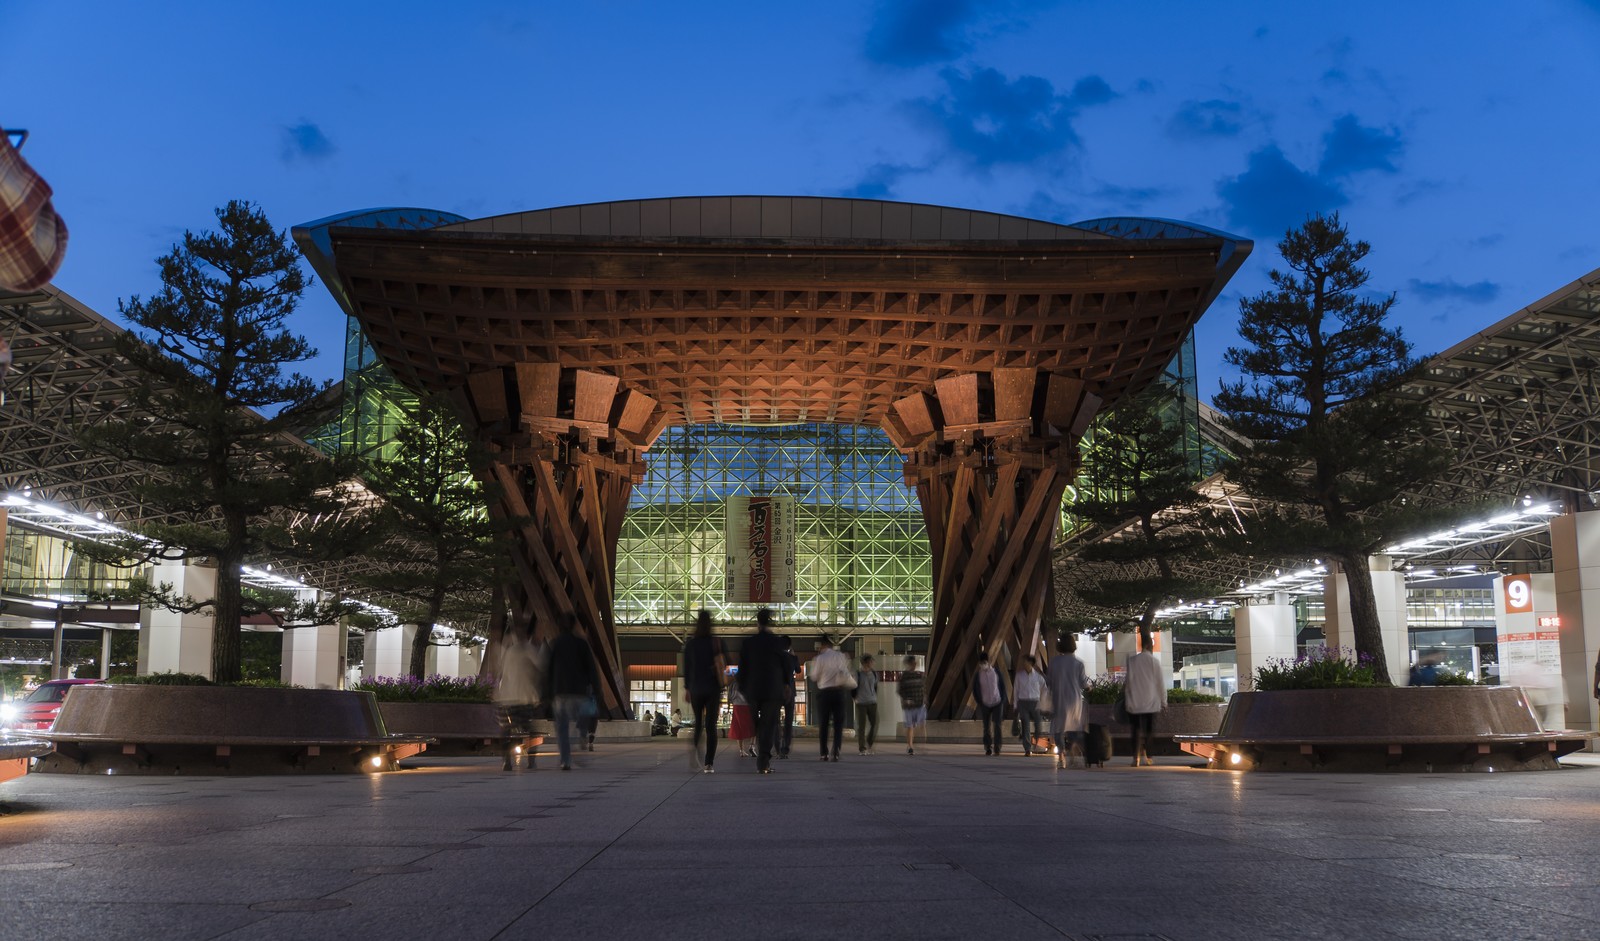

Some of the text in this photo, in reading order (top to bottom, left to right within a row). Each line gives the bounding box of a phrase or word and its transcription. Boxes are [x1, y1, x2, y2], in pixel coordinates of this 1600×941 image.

[748, 502, 771, 599] 百万石まつり
[1508, 580, 1528, 608] 9
